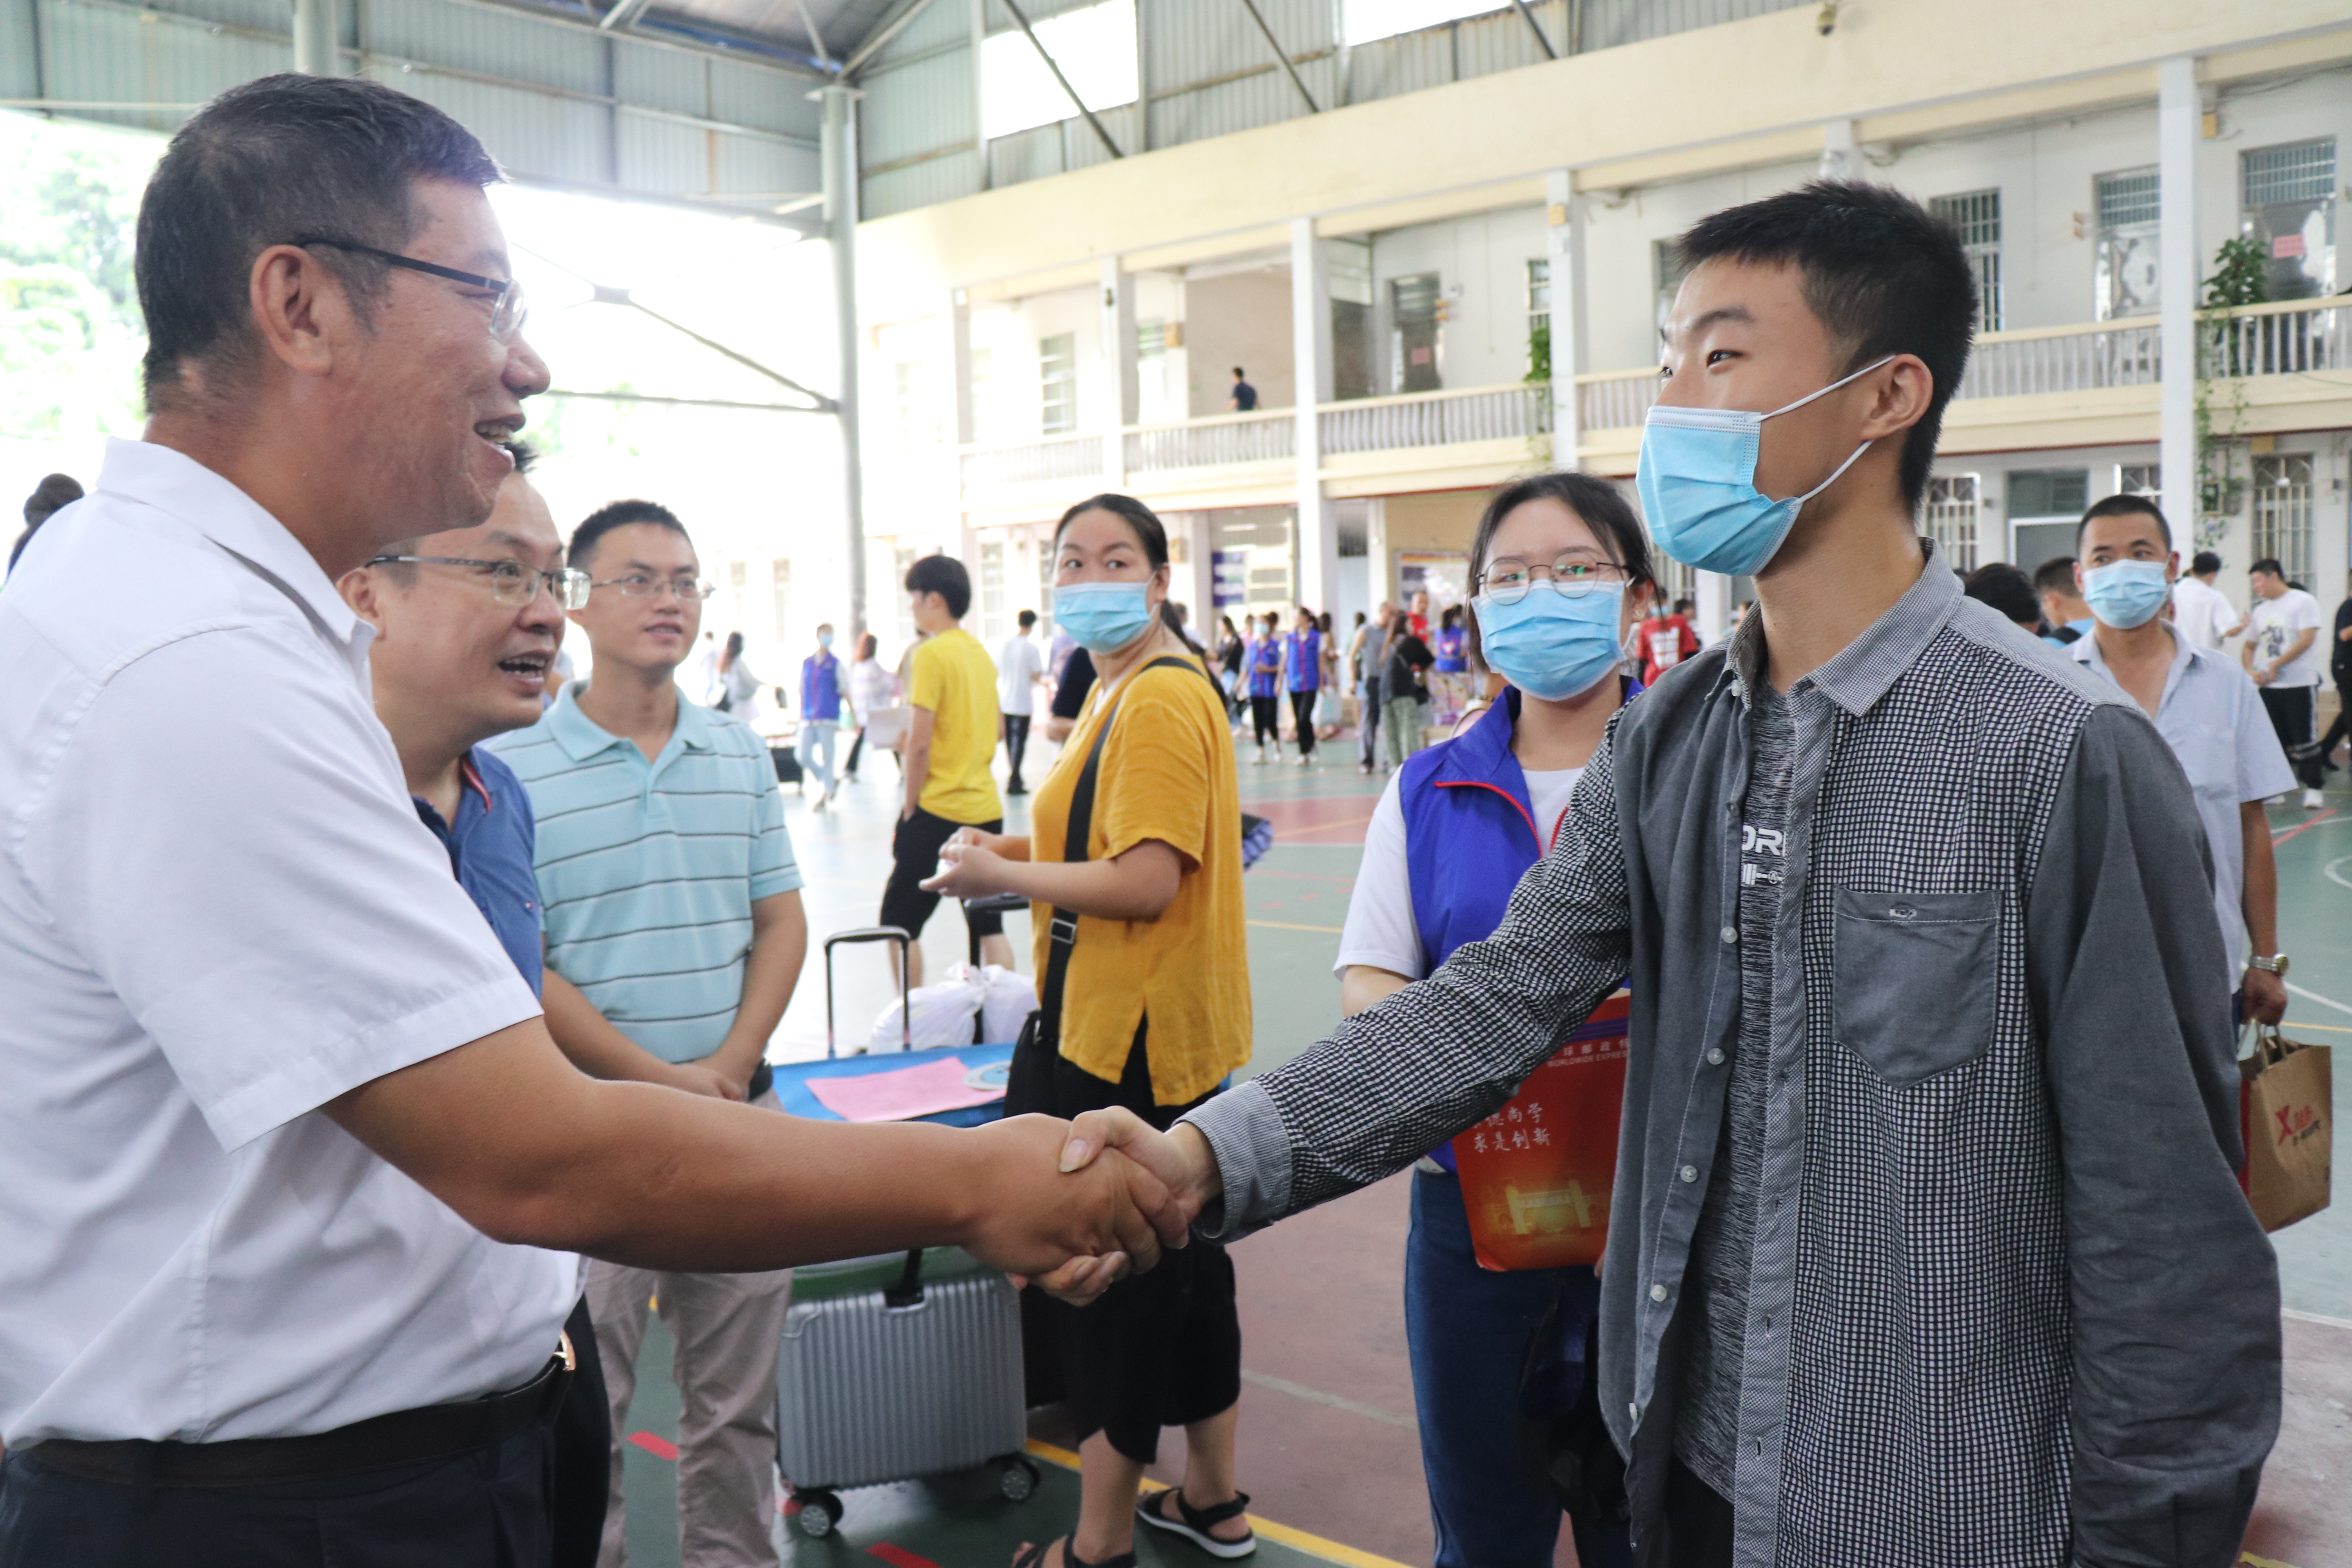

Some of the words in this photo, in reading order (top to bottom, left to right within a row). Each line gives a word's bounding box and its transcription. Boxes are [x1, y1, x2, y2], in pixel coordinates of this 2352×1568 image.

[1473, 1102, 1542, 1129] 德尚学
[1474, 1127, 1550, 1153] 求是创新
